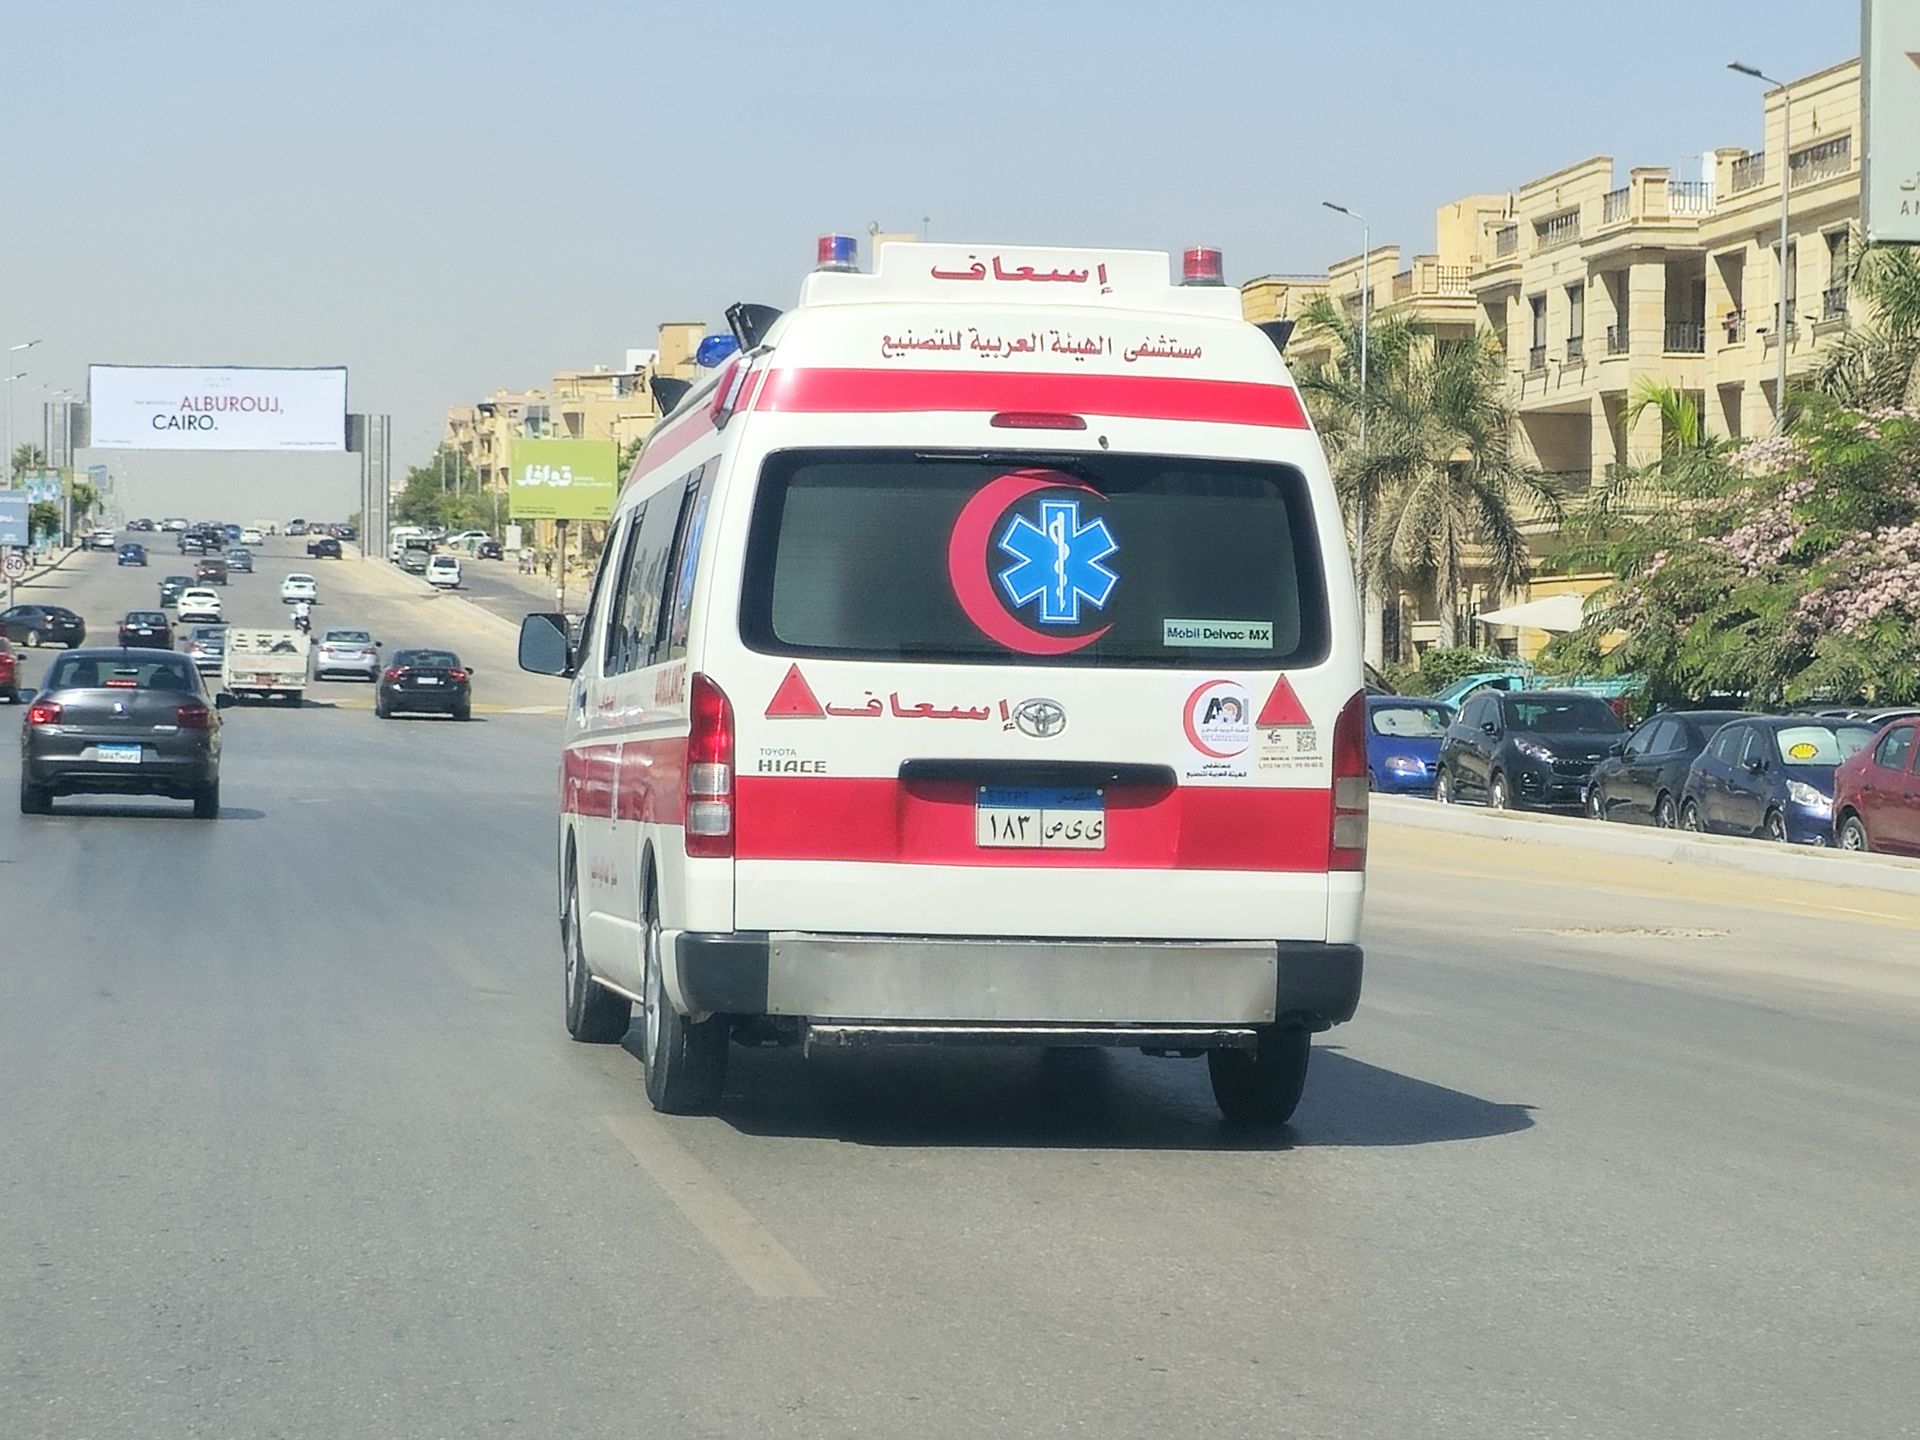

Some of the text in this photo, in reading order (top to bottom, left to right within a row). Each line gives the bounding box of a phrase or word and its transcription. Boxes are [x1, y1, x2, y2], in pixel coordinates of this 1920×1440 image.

[931, 255, 1114, 295] إسعاف
[881, 327, 1202, 362] مستشفى الهيئة العربية للتصنيع
[180, 396, 284, 414] ALBUROUJ,
[152, 414, 218, 431] CAIRO.
[515, 464, 573, 487] قوافل
[6, 559, 22, 571] 80
[1167, 627, 1270, 641] Mobil Delvac MX
[825, 691, 1016, 732] إسعاف
[759, 748, 797, 757] TOYOTA
[758, 759, 827, 774] HIACE
[991, 815, 1031, 840] ١٨٣
